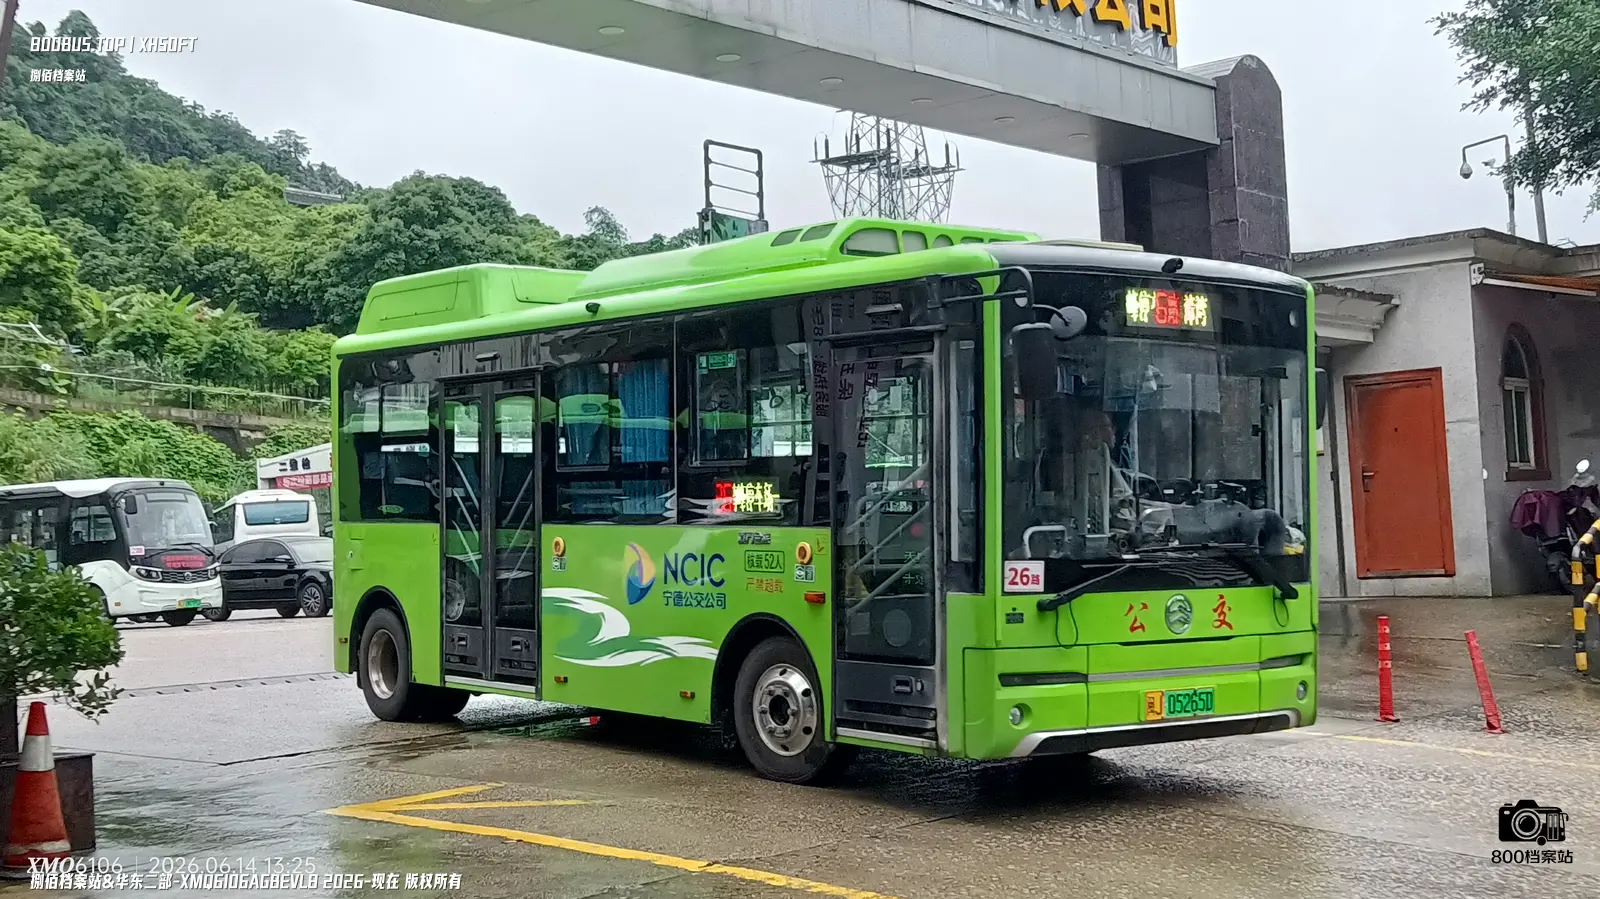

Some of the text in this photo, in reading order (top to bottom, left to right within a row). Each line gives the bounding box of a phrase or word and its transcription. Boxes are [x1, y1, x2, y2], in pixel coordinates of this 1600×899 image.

[663, 552, 726, 587] NCIC
[662, 590, 727, 610] 宁德公交公司
